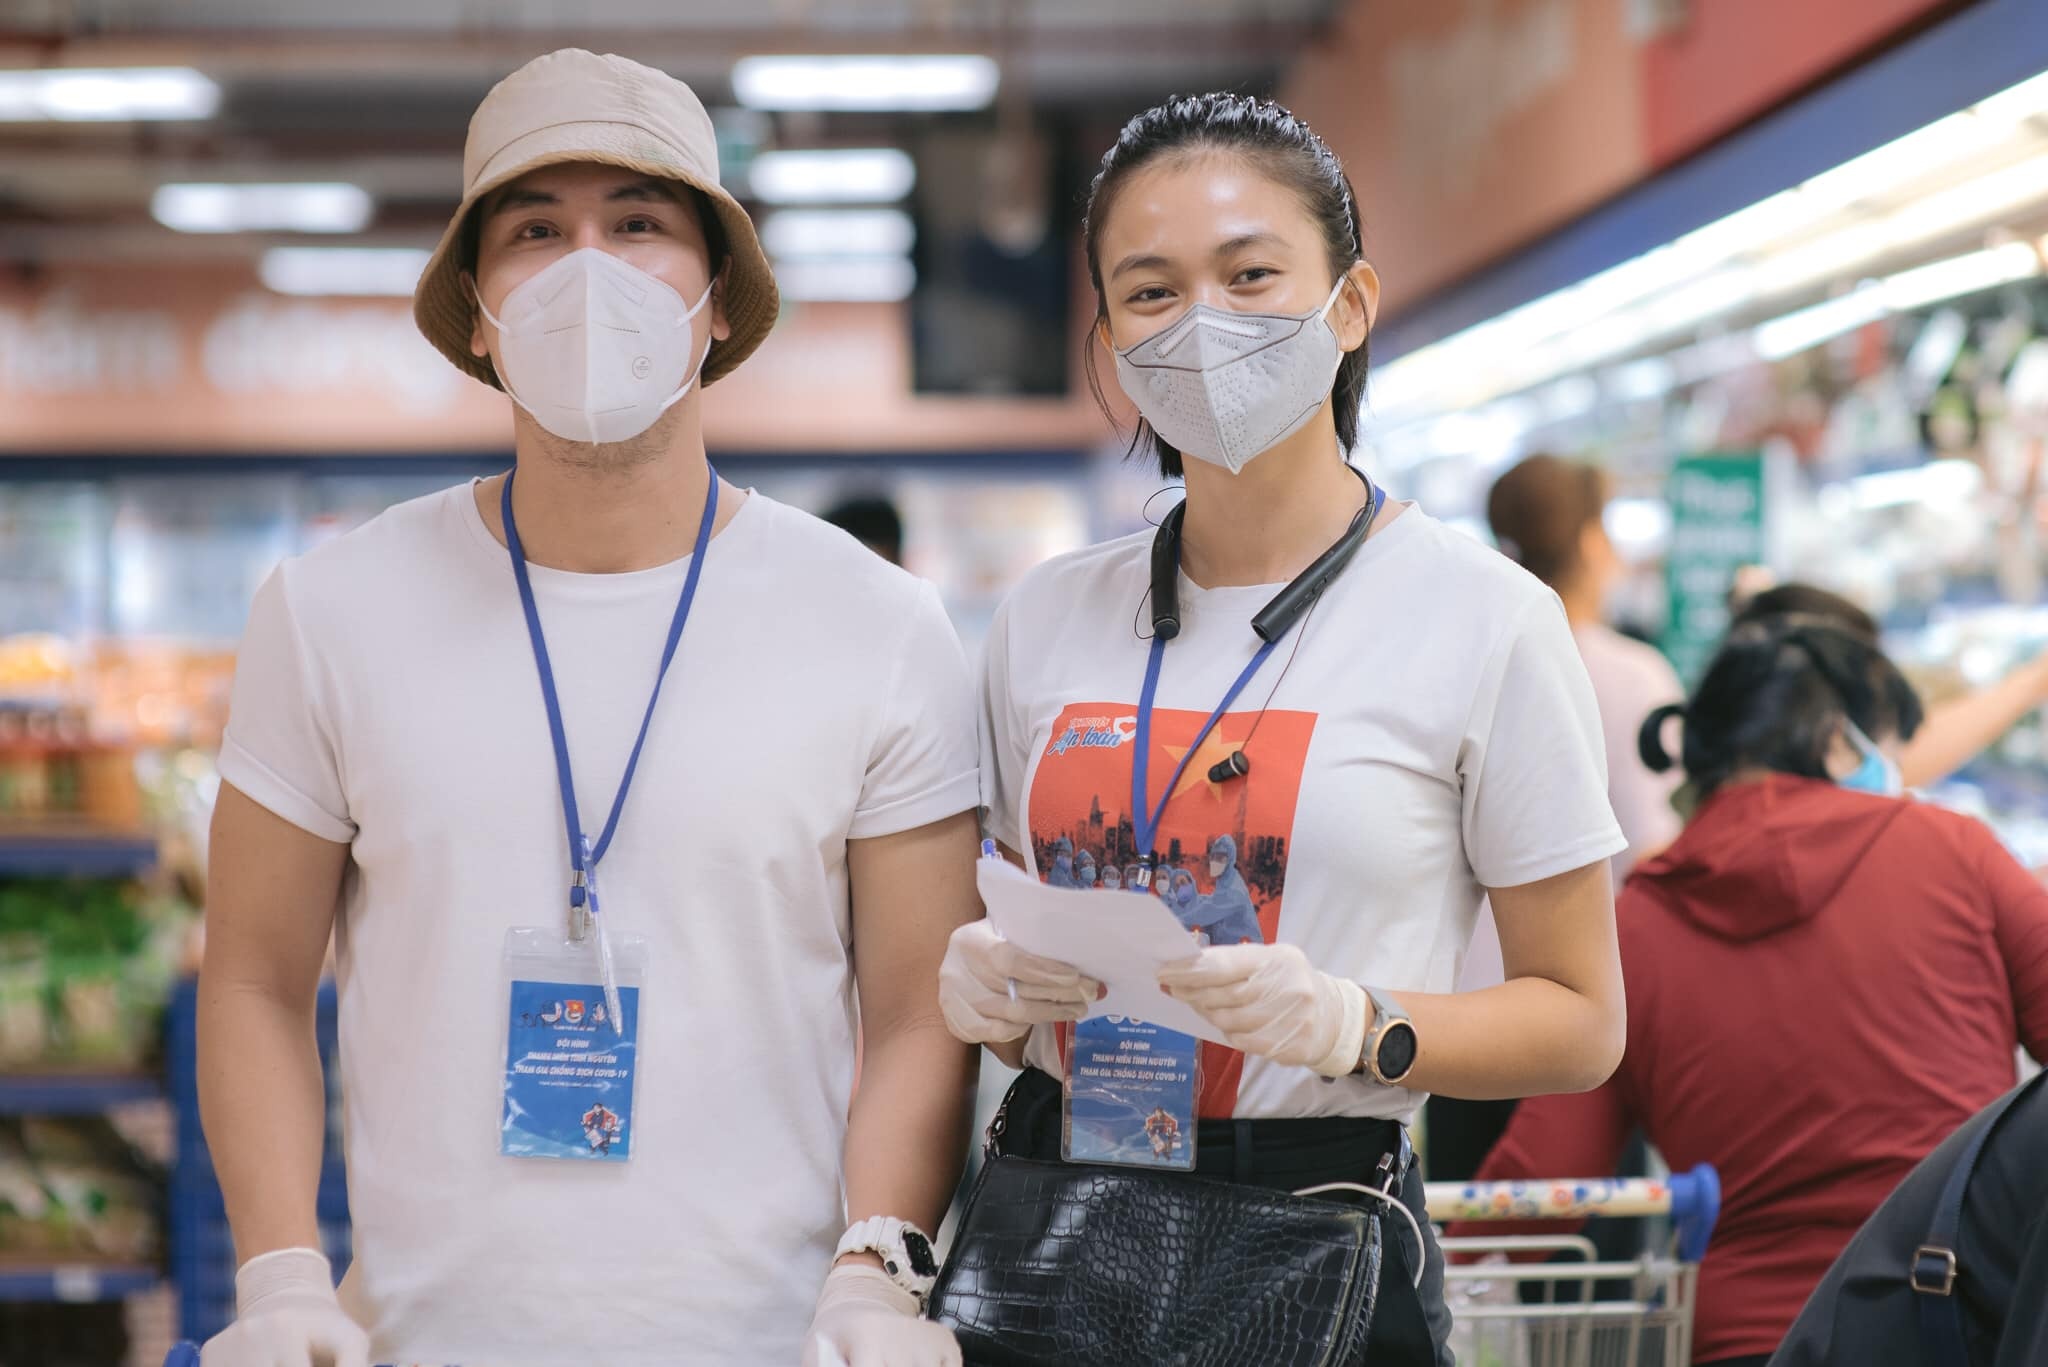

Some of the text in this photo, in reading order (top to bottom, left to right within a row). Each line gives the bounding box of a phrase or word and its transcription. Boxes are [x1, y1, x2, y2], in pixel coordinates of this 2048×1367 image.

[1047, 725, 1121, 756] An toàn
[594, 1068, 628, 1079] COVID-19
[1080, 1067, 1099, 1077] THAM
[1099, 1068, 1112, 1078] GIA
[1155, 1072, 1187, 1082] COVID-19
